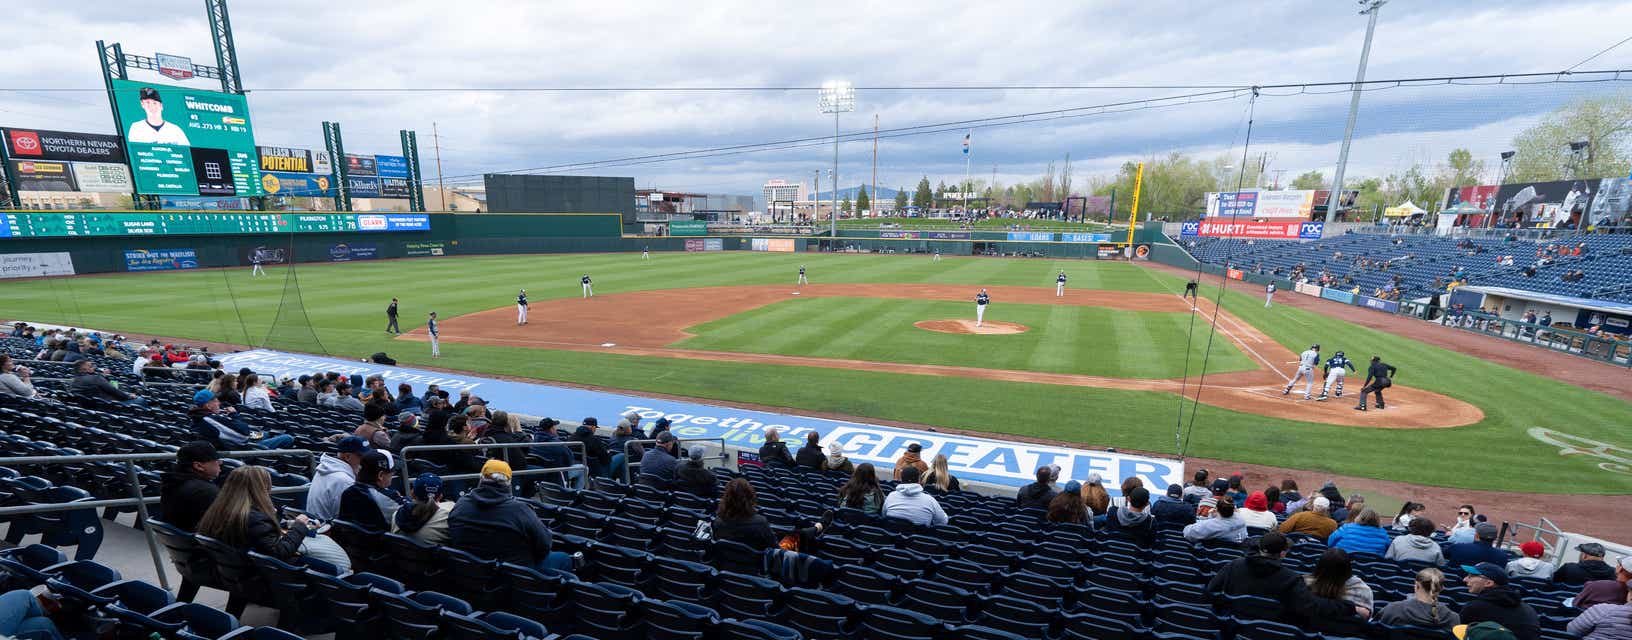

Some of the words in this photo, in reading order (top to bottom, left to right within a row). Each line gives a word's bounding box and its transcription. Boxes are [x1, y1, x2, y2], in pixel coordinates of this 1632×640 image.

[185, 100, 234, 113] WHITCOMB
[42, 137, 86, 147] NORTHERN
[87, 139, 118, 149] NEVADA
[45, 145, 76, 153] TOYOTA
[77, 146, 110, 155] DEALERS
[262, 156, 308, 171] POTENTIAL
[346, 221, 356, 229] 78
[1183, 222, 1198, 230] roc
[1212, 224, 1244, 234] HURT!
[1302, 224, 1322, 232] roc
[838, 430, 1172, 489] GREATER
